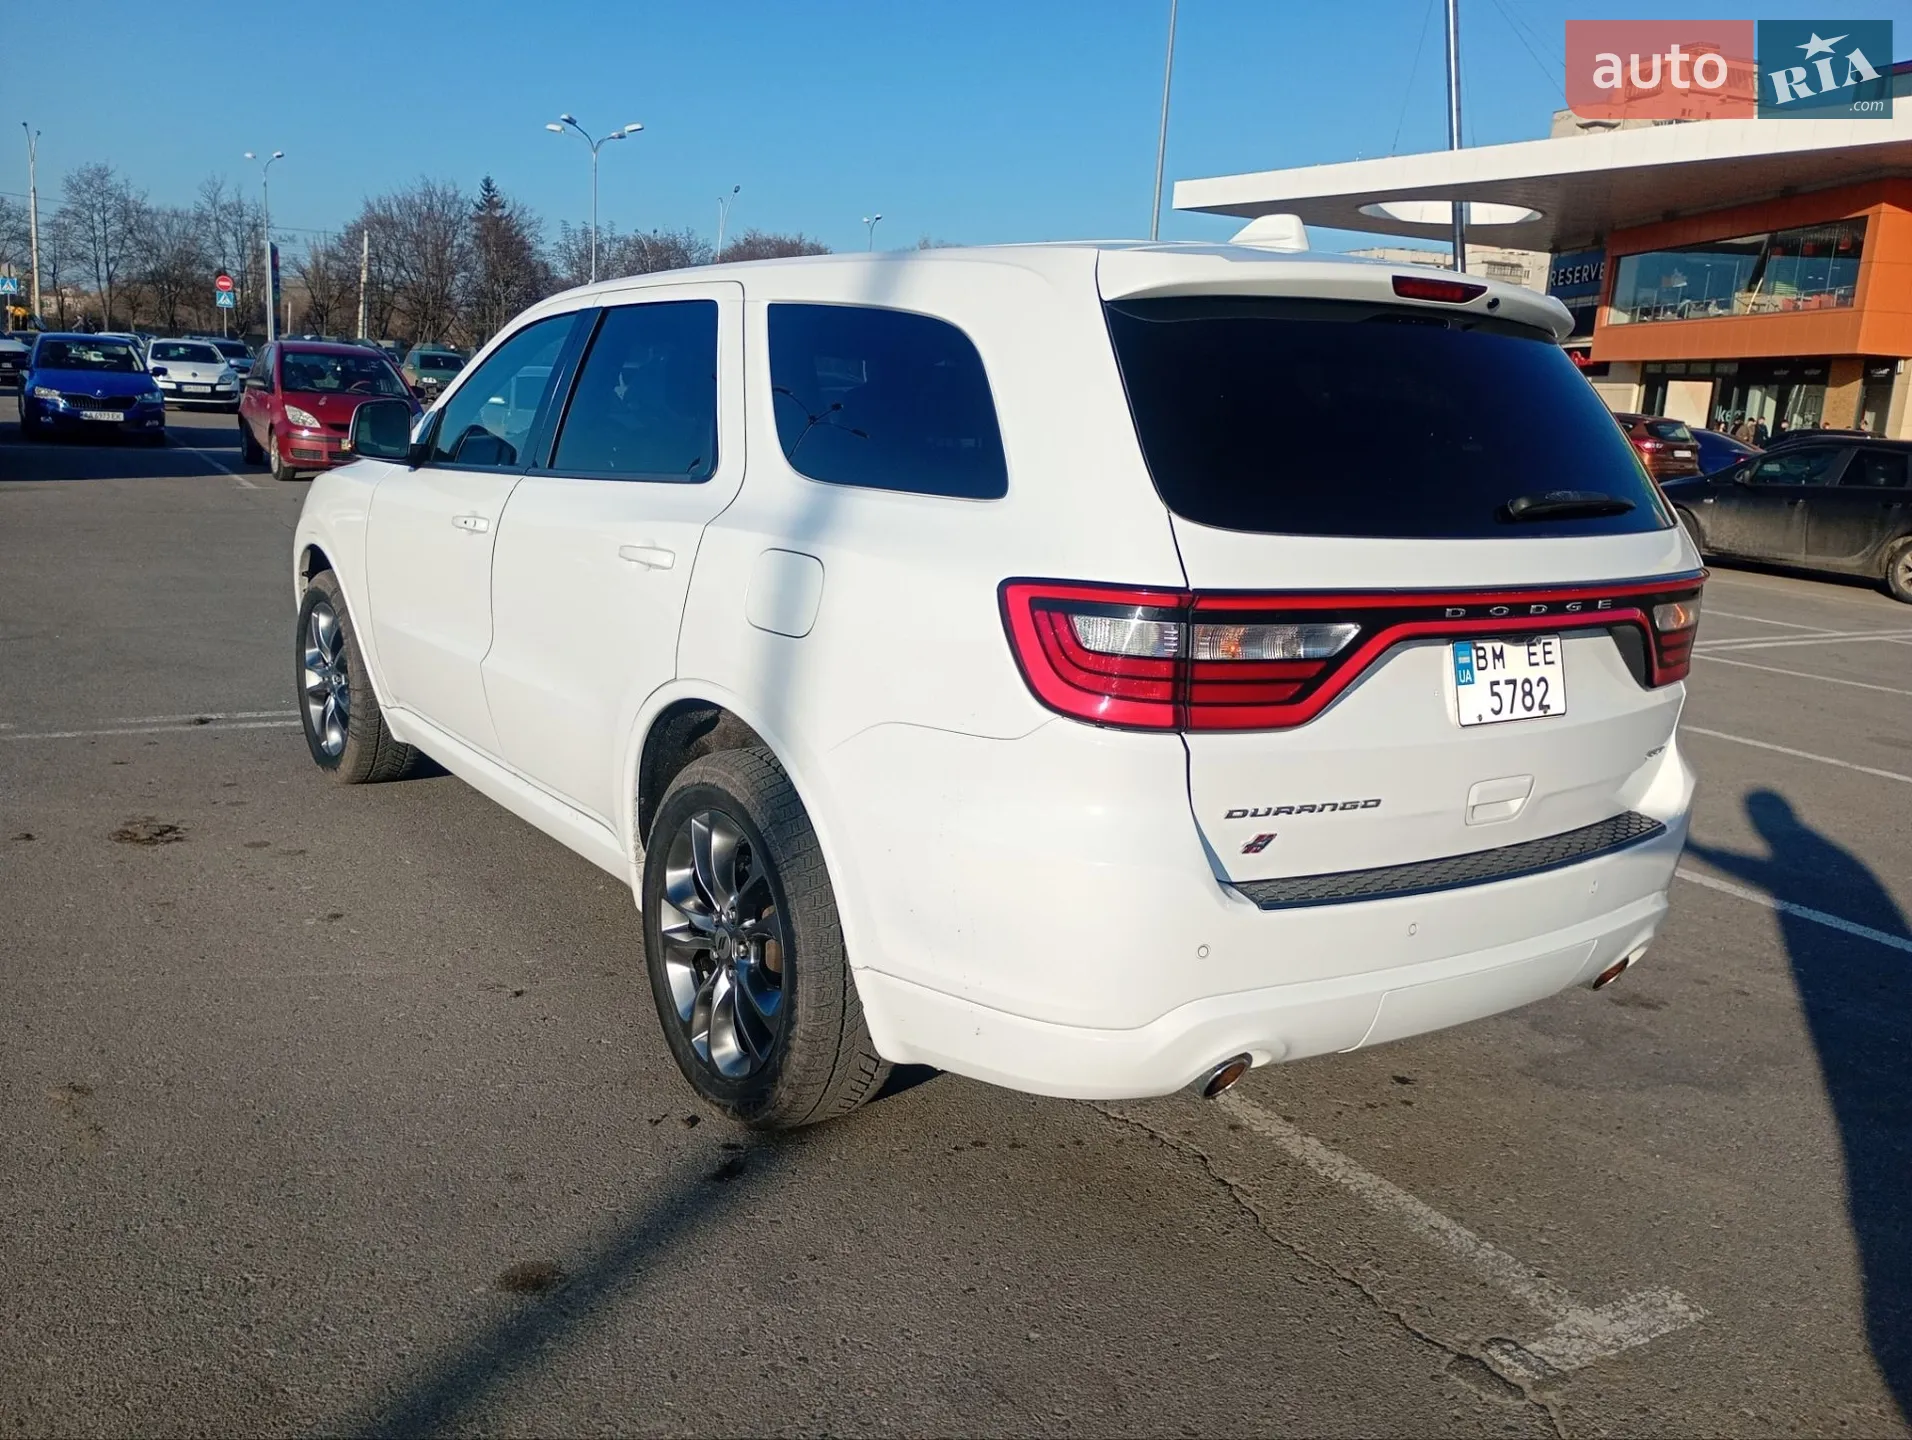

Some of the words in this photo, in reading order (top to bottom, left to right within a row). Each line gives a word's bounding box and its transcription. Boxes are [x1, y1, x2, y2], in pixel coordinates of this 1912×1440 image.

[1445, 599, 1612, 618] DODGE
[1475, 645, 1506, 671] BM
[1526, 641, 1555, 667] EE
[1458, 669, 1473, 684] UA
[1489, 676, 1551, 716] 5782
[1224, 798, 1382, 820] DURANGO
